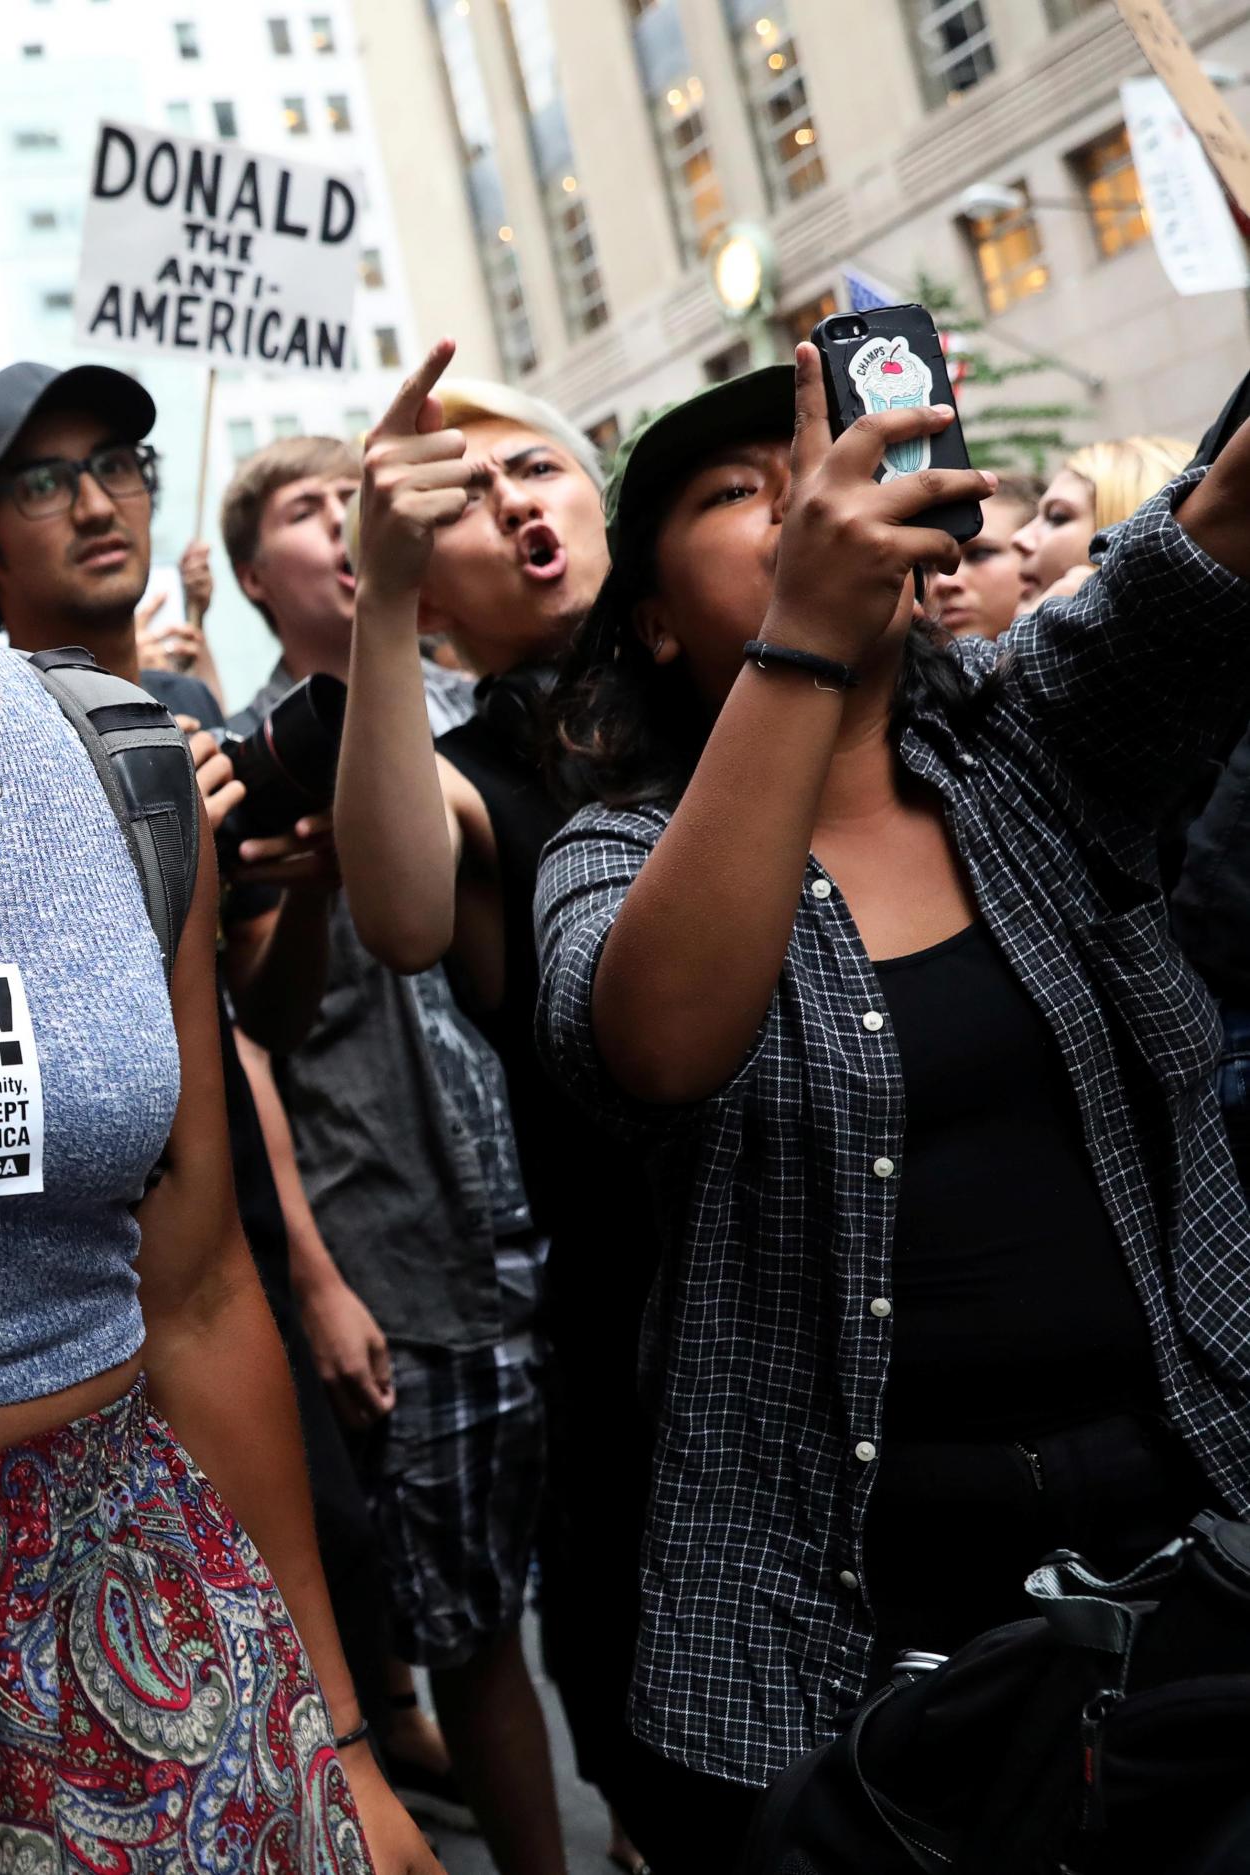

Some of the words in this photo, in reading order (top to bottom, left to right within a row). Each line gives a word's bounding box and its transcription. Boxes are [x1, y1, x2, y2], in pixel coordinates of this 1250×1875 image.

[93, 126, 356, 244] DONALD
[183, 223, 253, 263] THE
[156, 257, 280, 299] ANTI-
[88, 285, 347, 369] AMERICAN
[856, 346, 885, 376] CHAMPS
